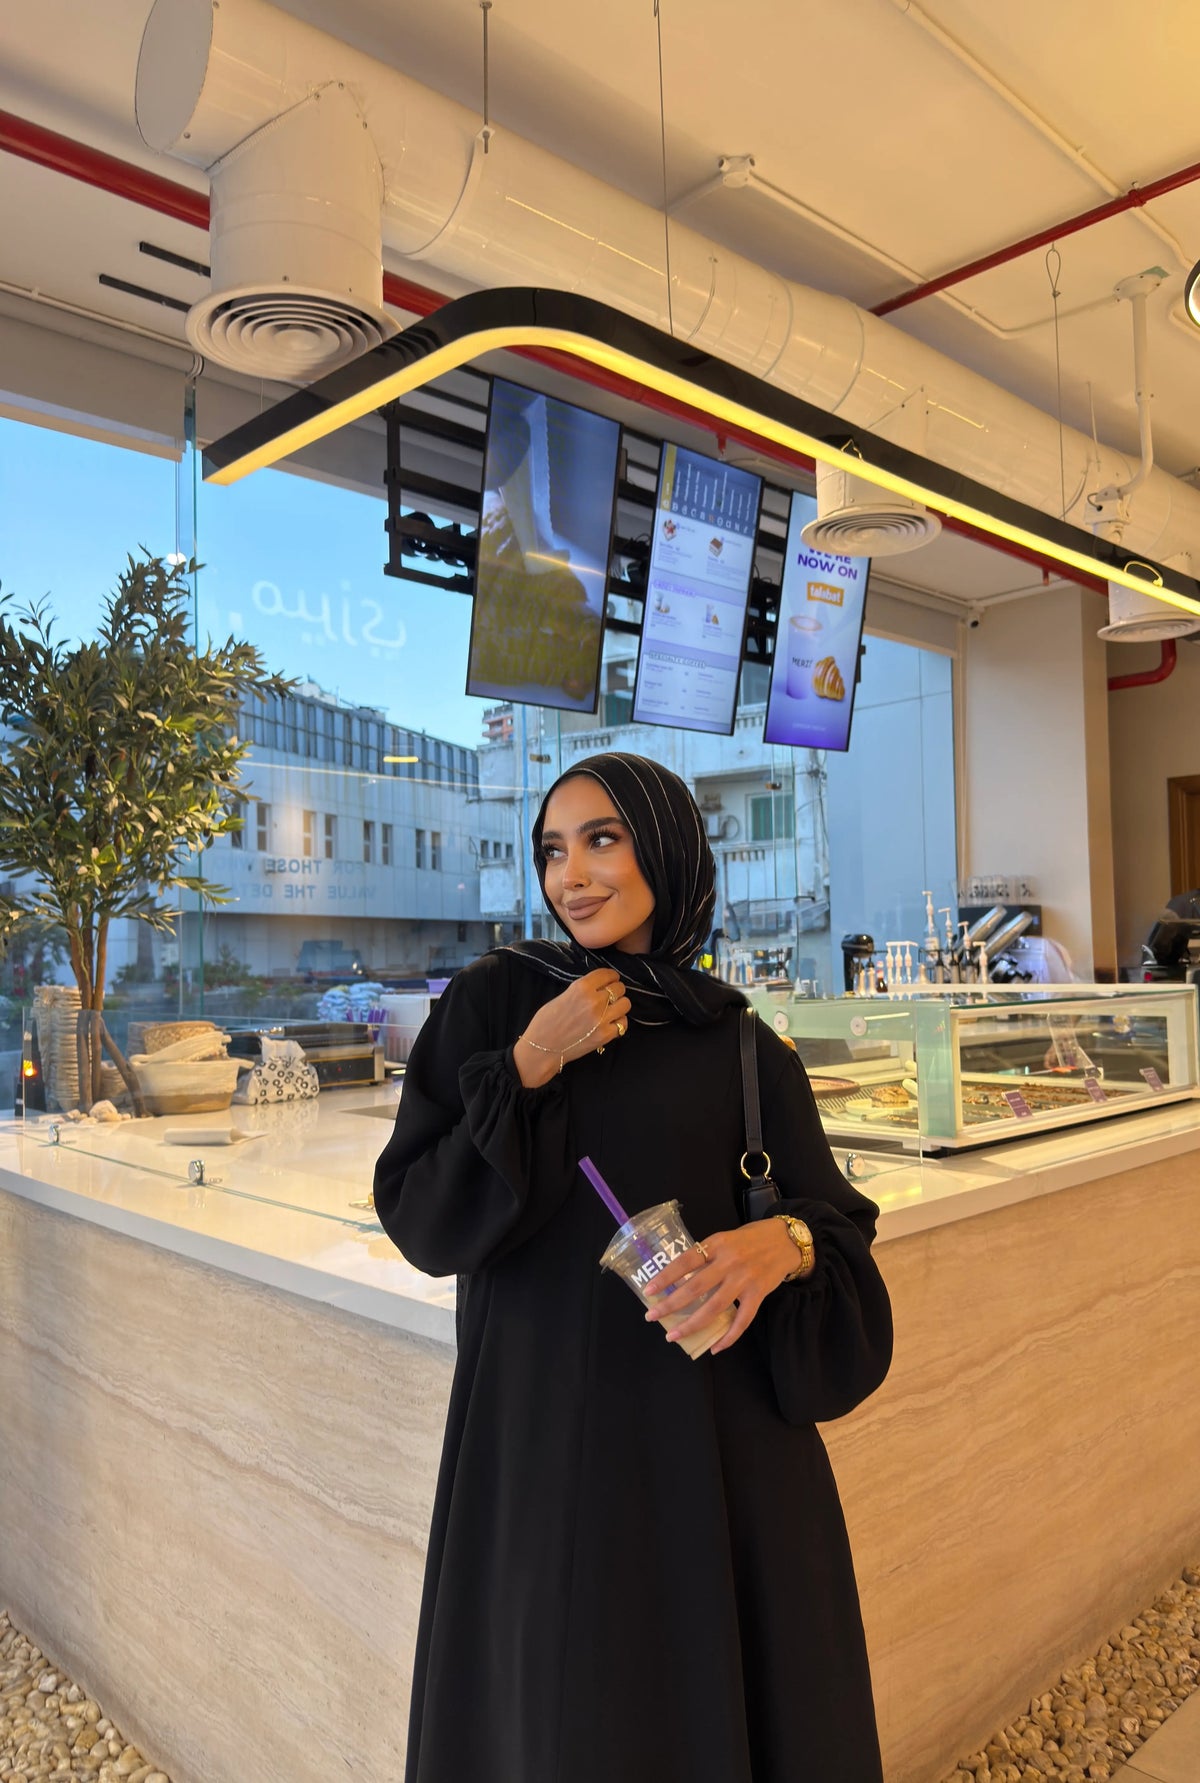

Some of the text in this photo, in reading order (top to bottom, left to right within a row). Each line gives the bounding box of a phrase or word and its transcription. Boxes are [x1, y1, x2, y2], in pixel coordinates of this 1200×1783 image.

[797, 553, 858, 580] NOW ON
[810, 584, 841, 603] talabat
[631, 1232, 689, 1289] MERZY
